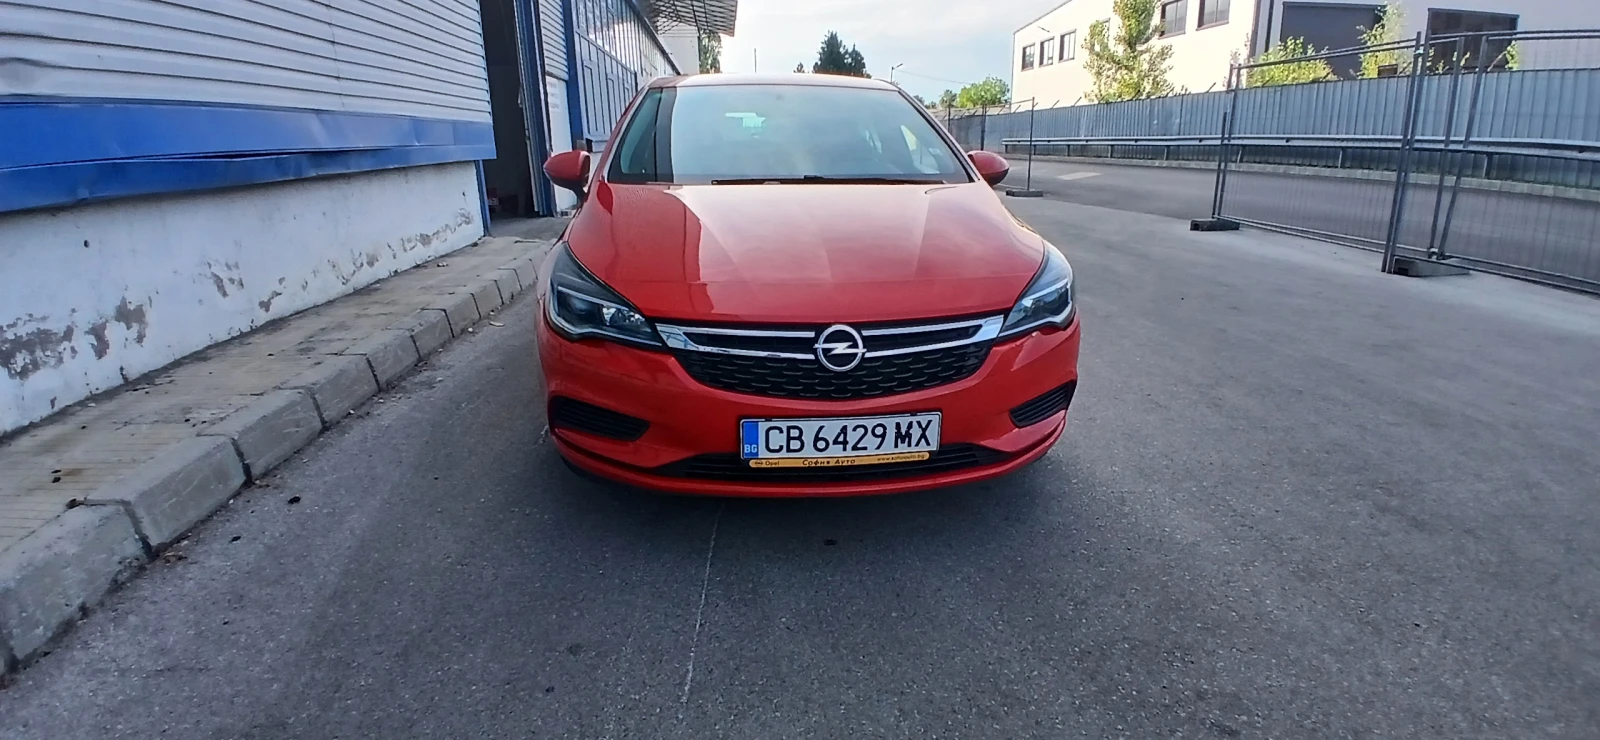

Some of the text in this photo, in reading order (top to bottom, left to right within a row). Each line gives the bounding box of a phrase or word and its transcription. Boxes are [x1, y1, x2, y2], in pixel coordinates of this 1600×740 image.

[765, 419, 933, 454] CB 6429 MX
[744, 444, 757, 453] BG
